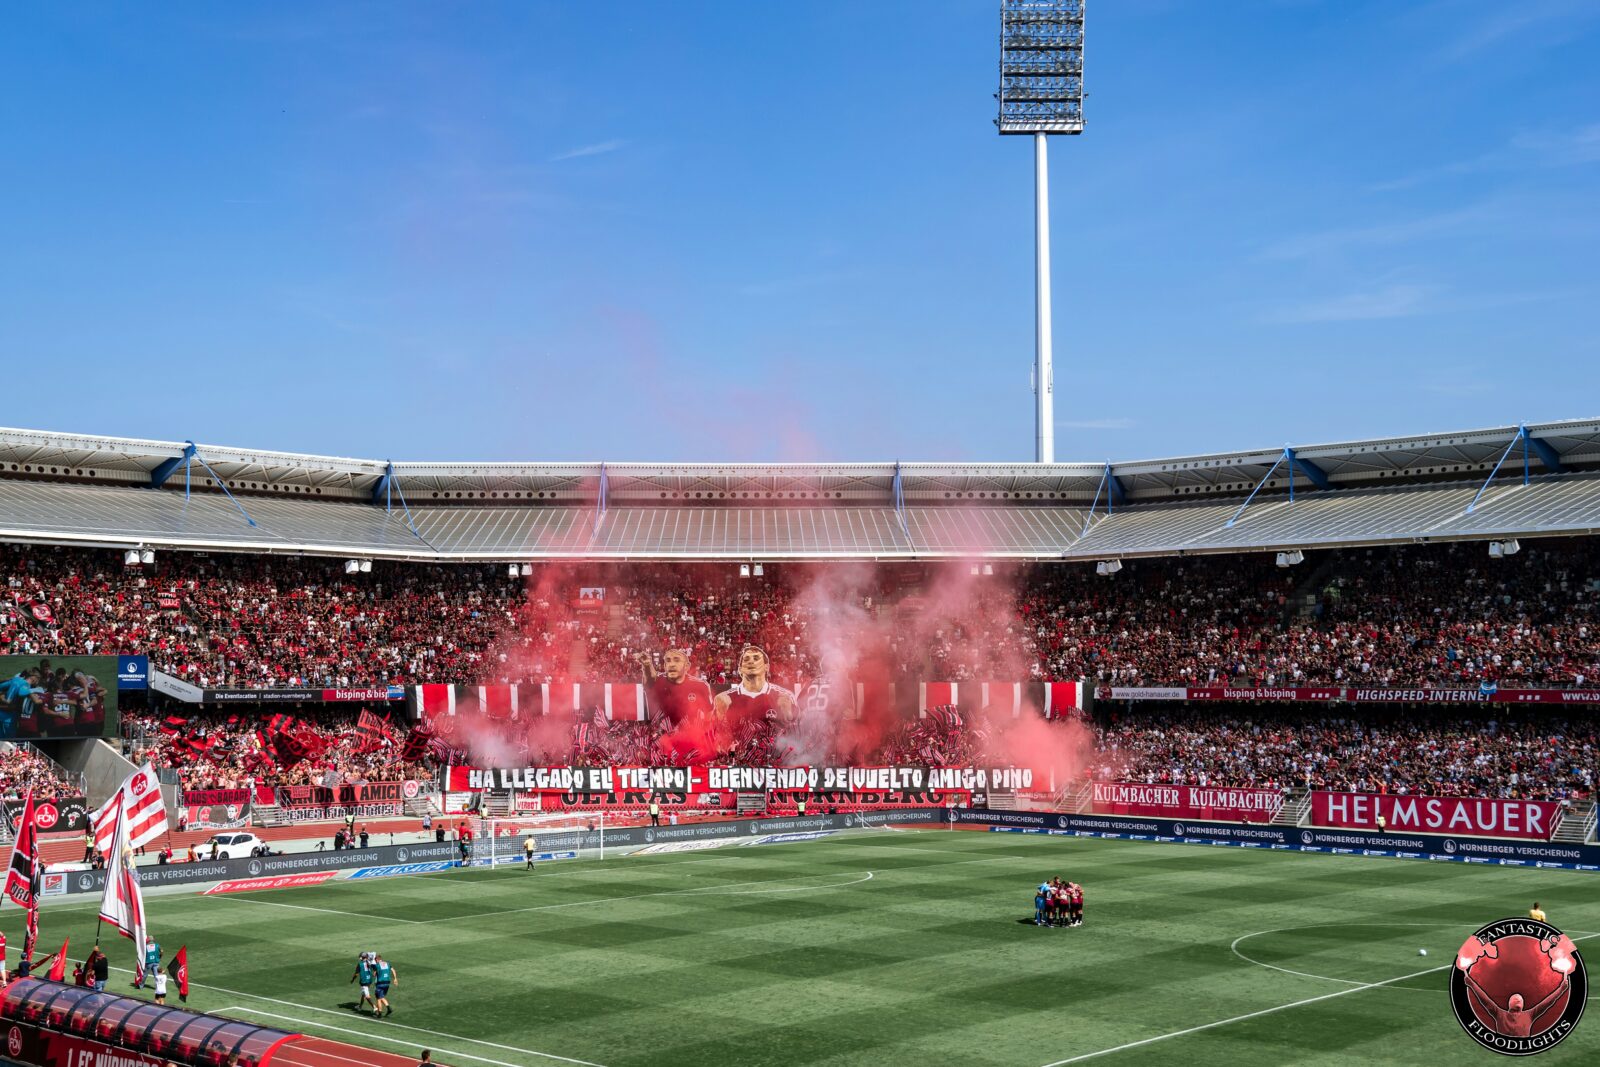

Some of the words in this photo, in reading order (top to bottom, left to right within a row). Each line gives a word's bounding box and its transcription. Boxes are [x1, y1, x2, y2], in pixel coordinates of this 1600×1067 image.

[336, 689, 366, 700] bisping
[366, 689, 373, 699] &
[807, 684, 831, 711] 25
[1115, 691, 1180, 699] www.gold-hanauer.de
[1224, 688, 1255, 700] bisping
[1256, 689, 1263, 698] &
[1264, 688, 1296, 700] bisping
[469, 769, 496, 788] HA
[500, 768, 584, 789] LLEGADO
[589, 768, 613, 789] EL
[617, 768, 685, 789] TIEMPO
[709, 768, 818, 789] BIENVENIDO
[824, 767, 848, 788] DE
[853, 768, 923, 789] VUELTO
[928, 768, 987, 789] AMIGO
[993, 768, 1032, 789] PINO
[361, 784, 401, 801] AMICI
[1094, 783, 1180, 805] KULMBACHER
[1189, 787, 1282, 811] KULMBACHER
[37, 814, 55, 823] FCN
[886, 812, 931, 821] VERSICHERUNG
[961, 813, 1001, 821] NÜRNBERGER
[1001, 815, 1044, 824] VERSICHERUNG
[1328, 794, 1544, 834] HELMSAUER
[760, 822, 795, 831] NÜRNBERGER
[796, 818, 833, 827] VERSICHERUNG
[1069, 818, 1110, 828] NÜRNBERGER
[1110, 821, 1158, 831] VERSICHERUNG
[656, 829, 695, 838] NÜRNBERGER
[696, 826, 737, 835] VERSICHERUNG
[1186, 825, 1231, 836] NÜRNBERGER
[1232, 828, 1284, 839] VERSICHERUNG
[1315, 833, 1365, 844] NÜRNBERGER
[1366, 837, 1424, 848] VERSICHERUNG
[411, 846, 459, 857] NÜRNBERGER
[1459, 842, 1514, 854] NÜRNBERGER
[1516, 846, 1581, 858] VERSICHERUNG
[265, 858, 318, 870] NÜRNBERGER
[321, 853, 378, 865] VERSICHERUNG
[98, 872, 159, 884] NRGER
[162, 866, 227, 879] VERSICHERUNG
[8, 1037, 21, 1050] FCN
[79, 1050, 94, 1067] FC
